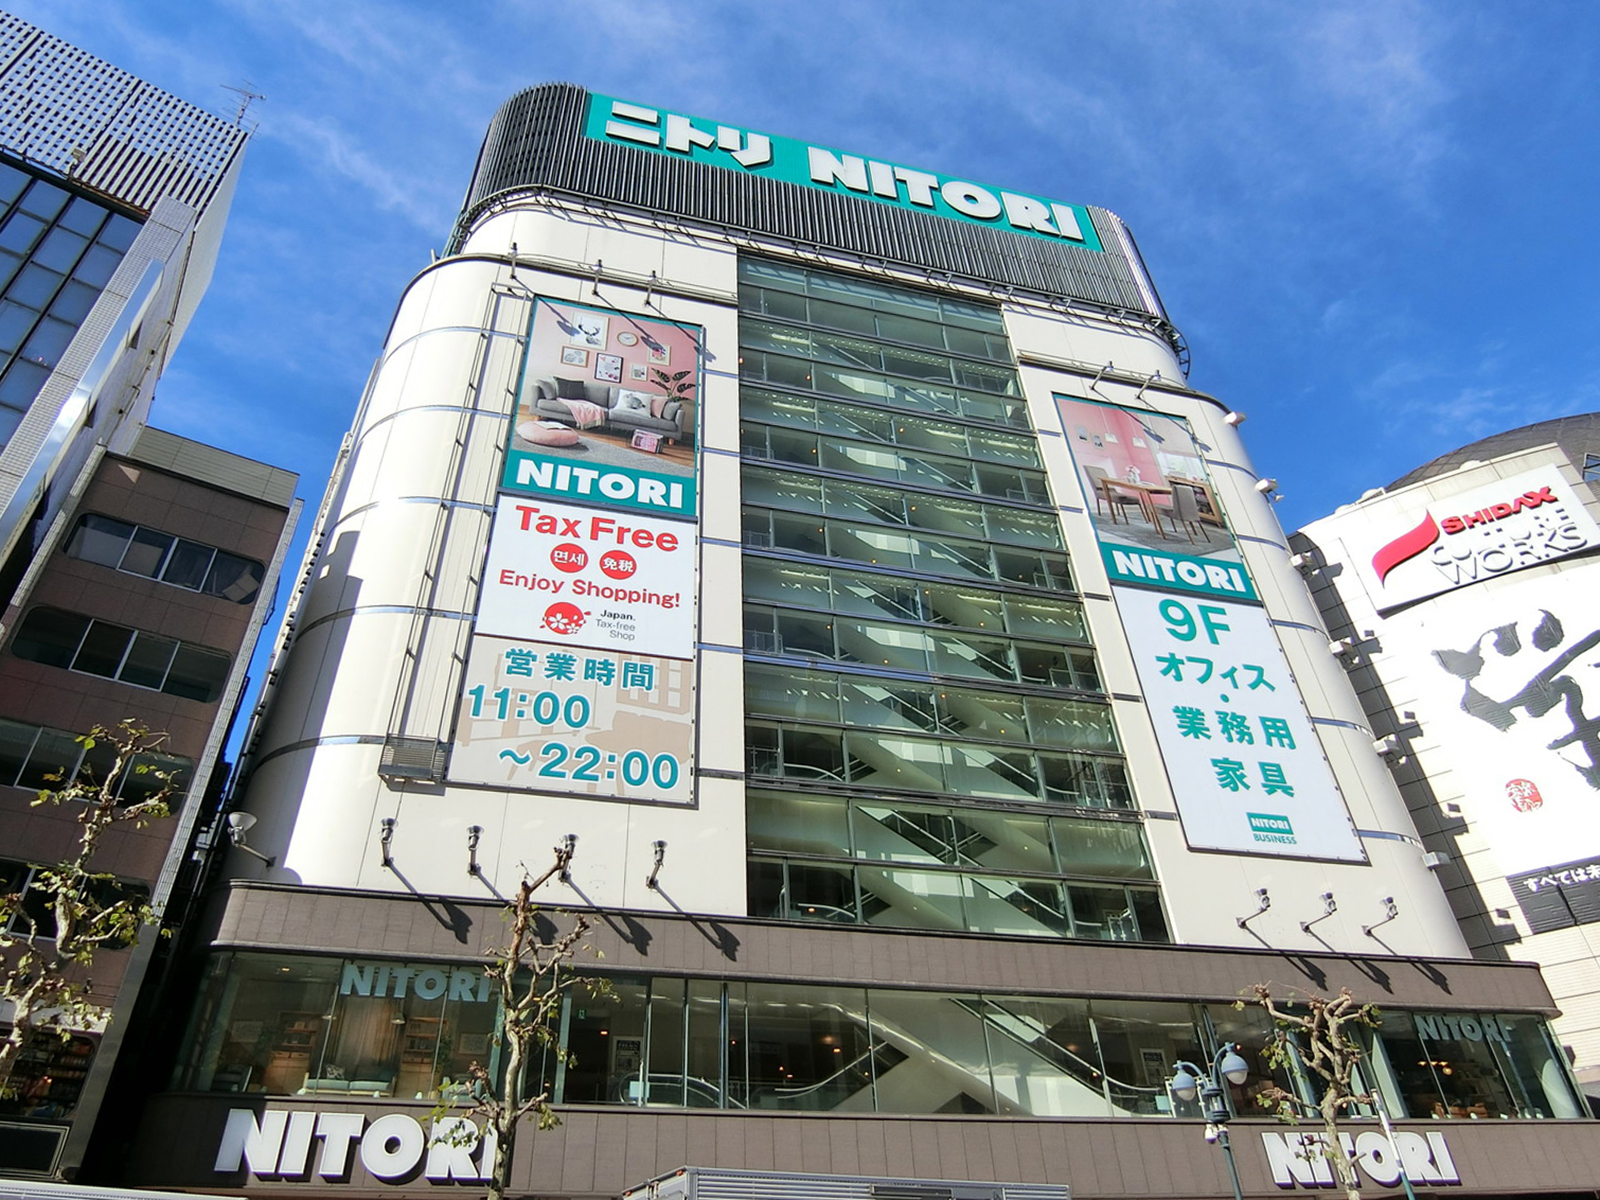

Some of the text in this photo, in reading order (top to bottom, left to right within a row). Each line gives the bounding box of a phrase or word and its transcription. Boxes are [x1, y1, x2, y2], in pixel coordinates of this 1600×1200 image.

[605, 100, 1084, 241] ニトリ NITORI
[516, 458, 683, 509] NITORI
[515, 505, 679, 552] Tax Free
[1440, 485, 1559, 535] SHIDAX
[1431, 503, 1573, 566] CUURE
[1435, 521, 1588, 585] WORKS
[554, 550, 585, 567] 면세
[602, 556, 634, 573] 免税
[1111, 550, 1246, 593] NITORI
[498, 569, 681, 609] Enjoy Shopping!
[595, 618, 636, 632] Tax-free
[600, 609, 636, 621] Japan.
[609, 629, 636, 642] Shop
[1158, 598, 1231, 646] 9F
[504, 647, 654, 691] 営業時間
[1155, 652, 1276, 692] オフィス
[468, 684, 591, 729] 11:00
[1172, 705, 1297, 750] 業務用
[1210, 757, 1295, 798] 家具
[1250, 817, 1290, 830] NITORI
[1252, 833, 1297, 845] BUSINESS
[340, 964, 491, 1003] NITORI
[1413, 1015, 1512, 1042] NITORI
[214, 1109, 498, 1180] NITORI
